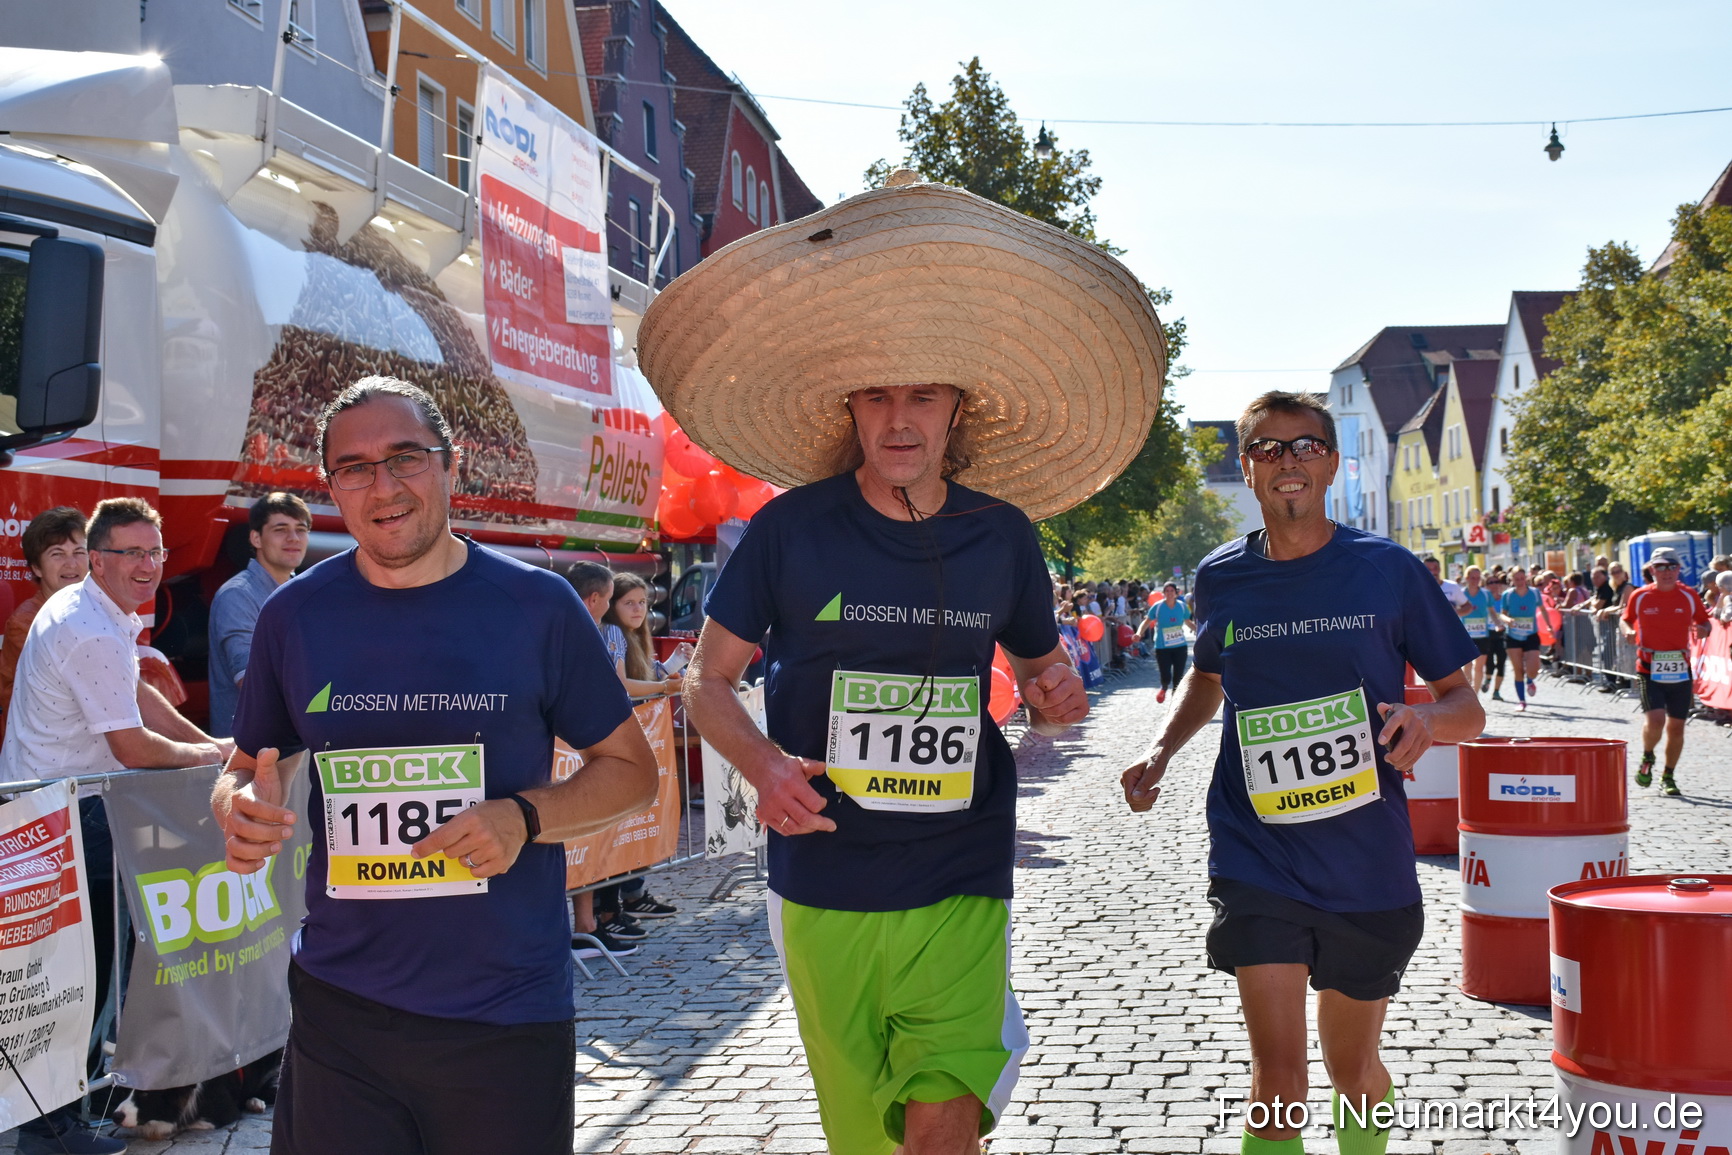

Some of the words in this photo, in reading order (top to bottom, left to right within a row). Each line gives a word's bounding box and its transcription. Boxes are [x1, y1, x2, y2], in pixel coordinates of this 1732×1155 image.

[497, 201, 558, 260] Heizungen
[584, 435, 650, 506] Pellets
[843, 604, 907, 623] GOSSEN
[1235, 622, 1288, 642] GOSSEN
[1292, 614, 1376, 635] METRAWATT
[1656, 662, 1685, 672] 2431
[331, 694, 398, 711] GOSSEN
[403, 693, 508, 711] METRAWATT
[844, 679, 972, 712] BOCK
[1246, 695, 1358, 741] BOCK
[850, 722, 965, 765] 1186
[330, 752, 469, 788] BOCK
[1258, 734, 1360, 785] 1183
[866, 776, 942, 796] ARMIN
[1276, 781, 1356, 811] JÜRGEN
[341, 799, 463, 846] 1185
[357, 859, 445, 881] ROMAN
[1578, 851, 1628, 880] AVI
[141, 855, 276, 945] BOCK
[27, 956, 43, 979] GmbH
[155, 952, 208, 987] inspired
[215, 949, 235, 975] by
[9, 982, 46, 1004] Grünberg
[45, 976, 50, 992] 8
[25, 986, 84, 1019] Neumarkt-Pölling
[29, 1021, 56, 1044] 2307-0
